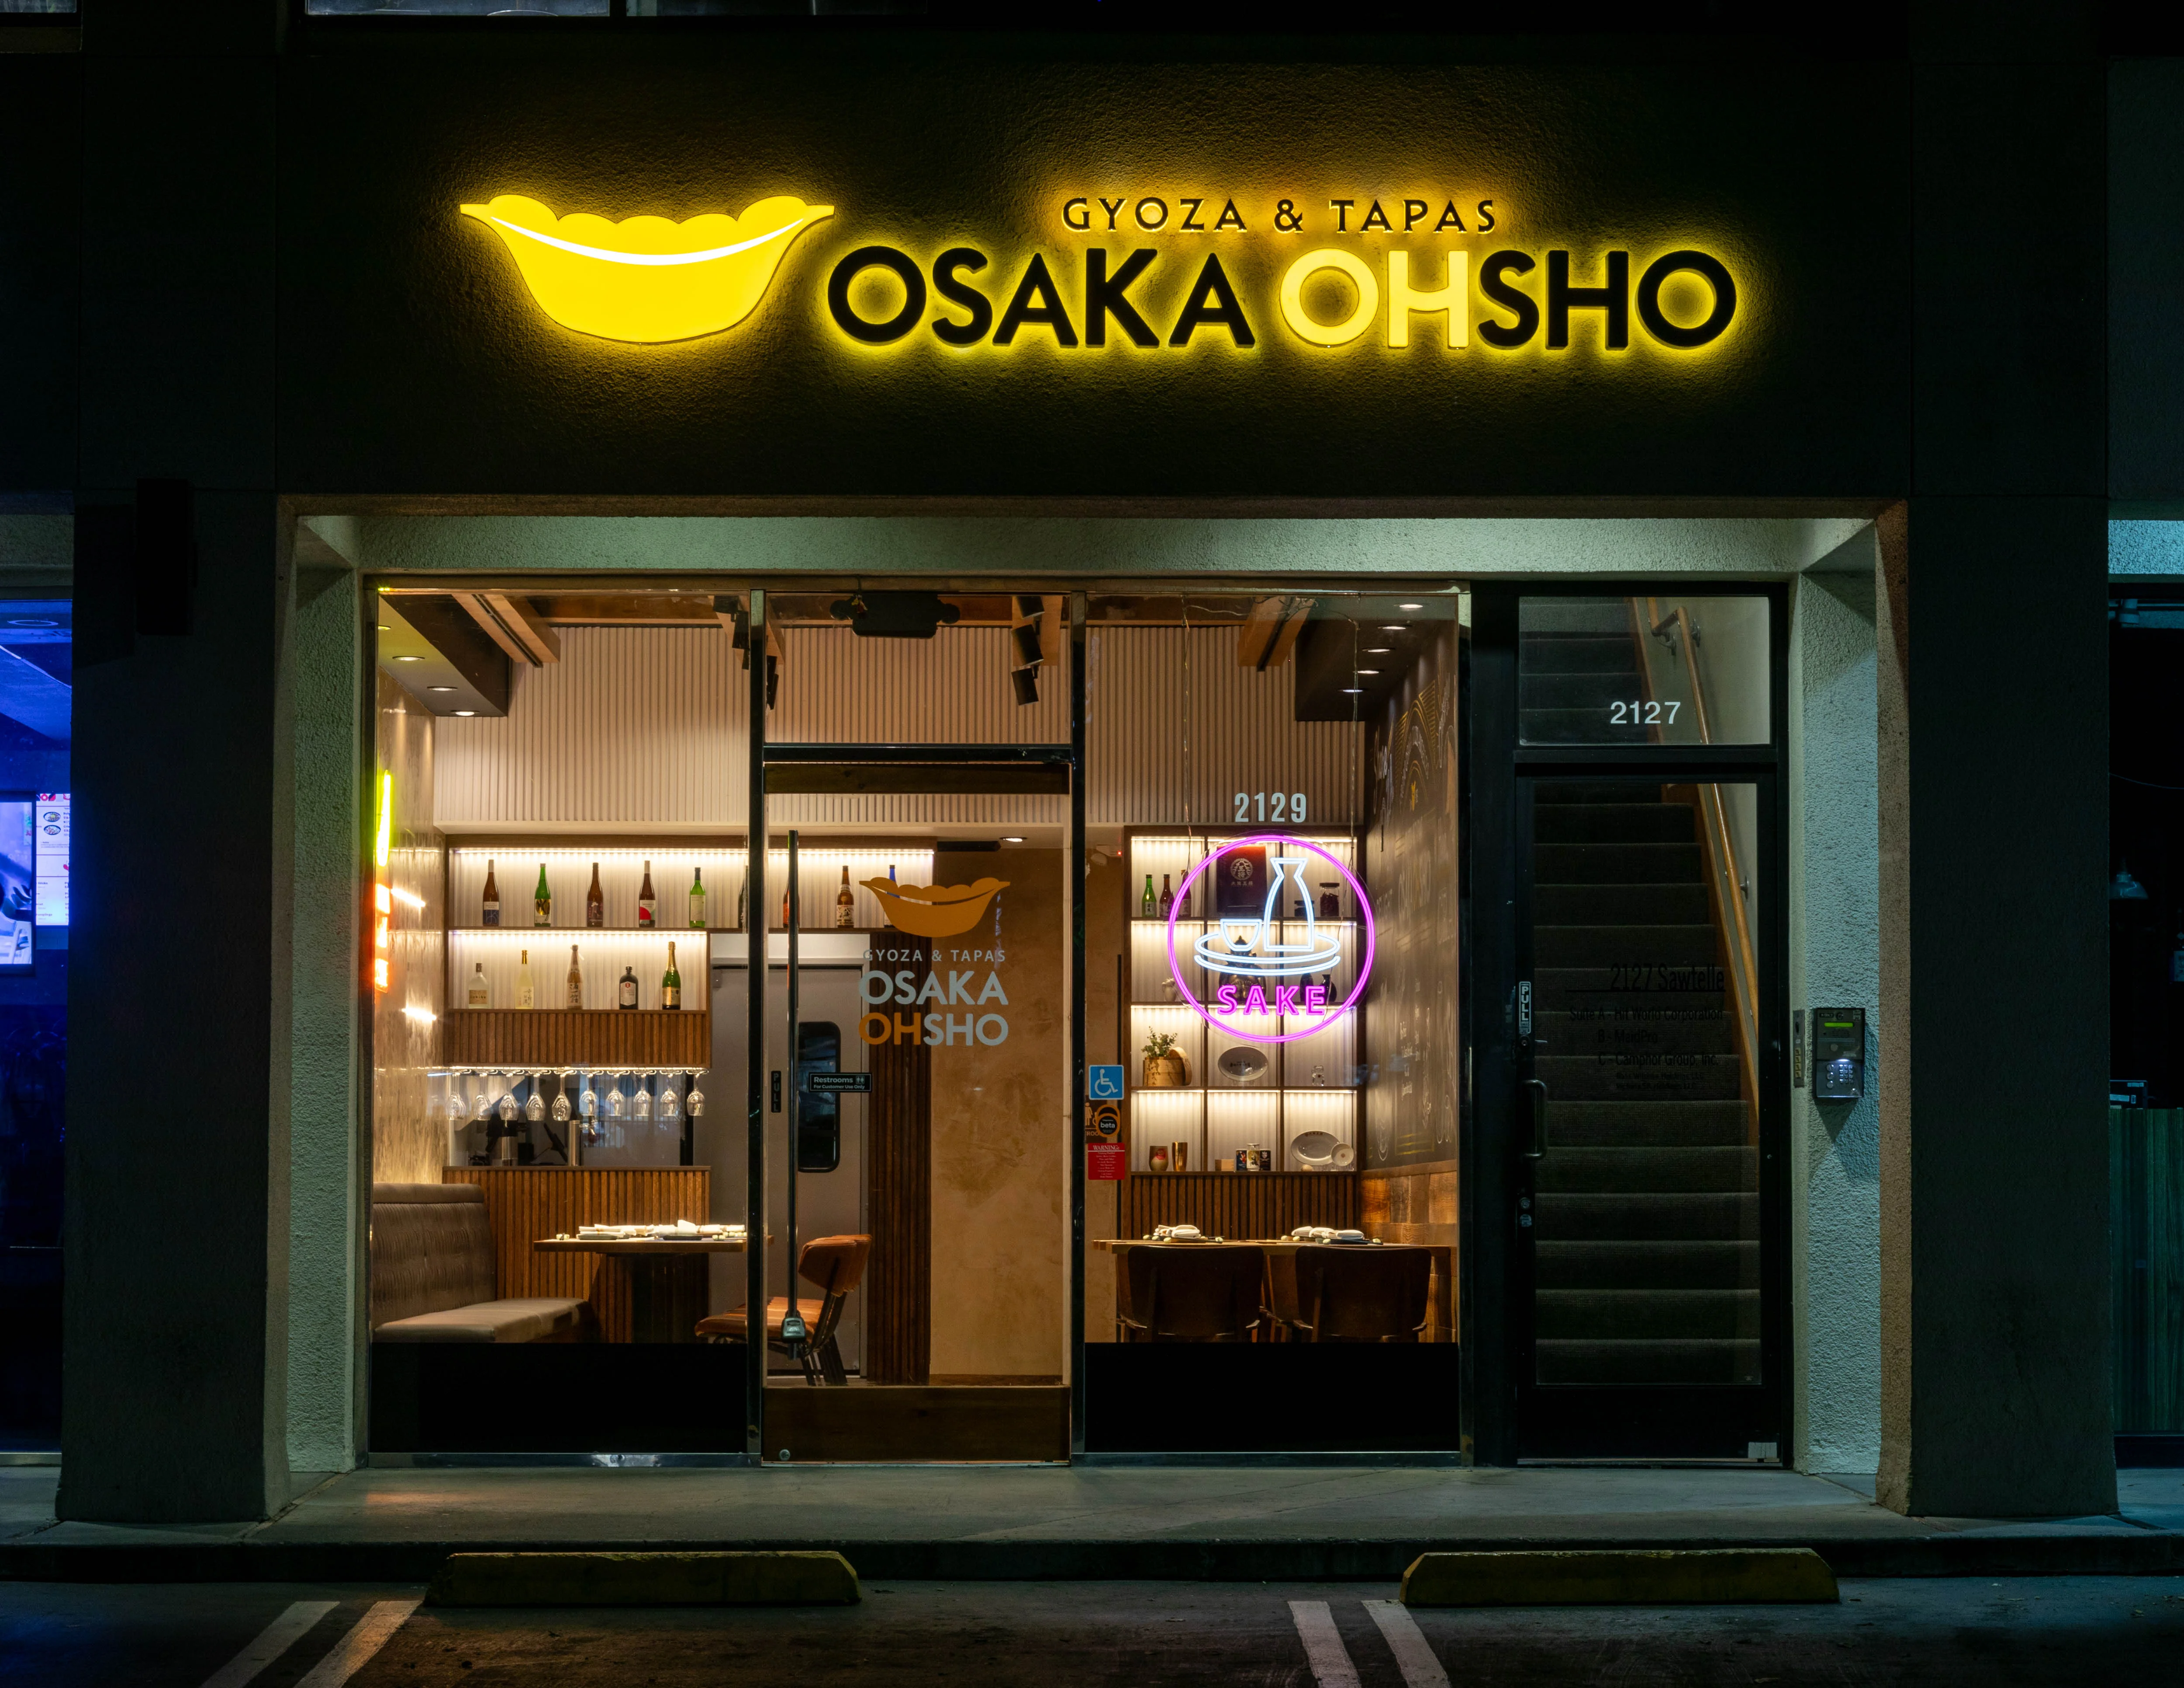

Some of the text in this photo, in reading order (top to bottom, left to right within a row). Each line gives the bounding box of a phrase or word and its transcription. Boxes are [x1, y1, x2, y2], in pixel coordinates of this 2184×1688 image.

[1063, 198, 1497, 234] GYOZA & TAPAS
[826, 245, 1738, 349] OSAKA OHSHO
[1610, 701, 1681, 724] 2127
[1234, 792, 1306, 823] 2129
[863, 949, 1006, 961] GYOZA & TAPAS
[858, 970, 1009, 1005] OSAKA
[1610, 963, 1724, 990] 2127 Sawtelle
[1217, 986, 1325, 1015] SAKE
[1570, 1008, 1595, 1020] Suite
[1599, 1007, 1605, 1020] A
[1665, 1007, 1724, 1023] Corporation
[858, 1013, 1009, 1046] OHSHO
[1599, 1052, 1605, 1066] C
[1616, 1052, 1661, 1069] Camphor
[1702, 1052, 1718, 1066] Inc.
